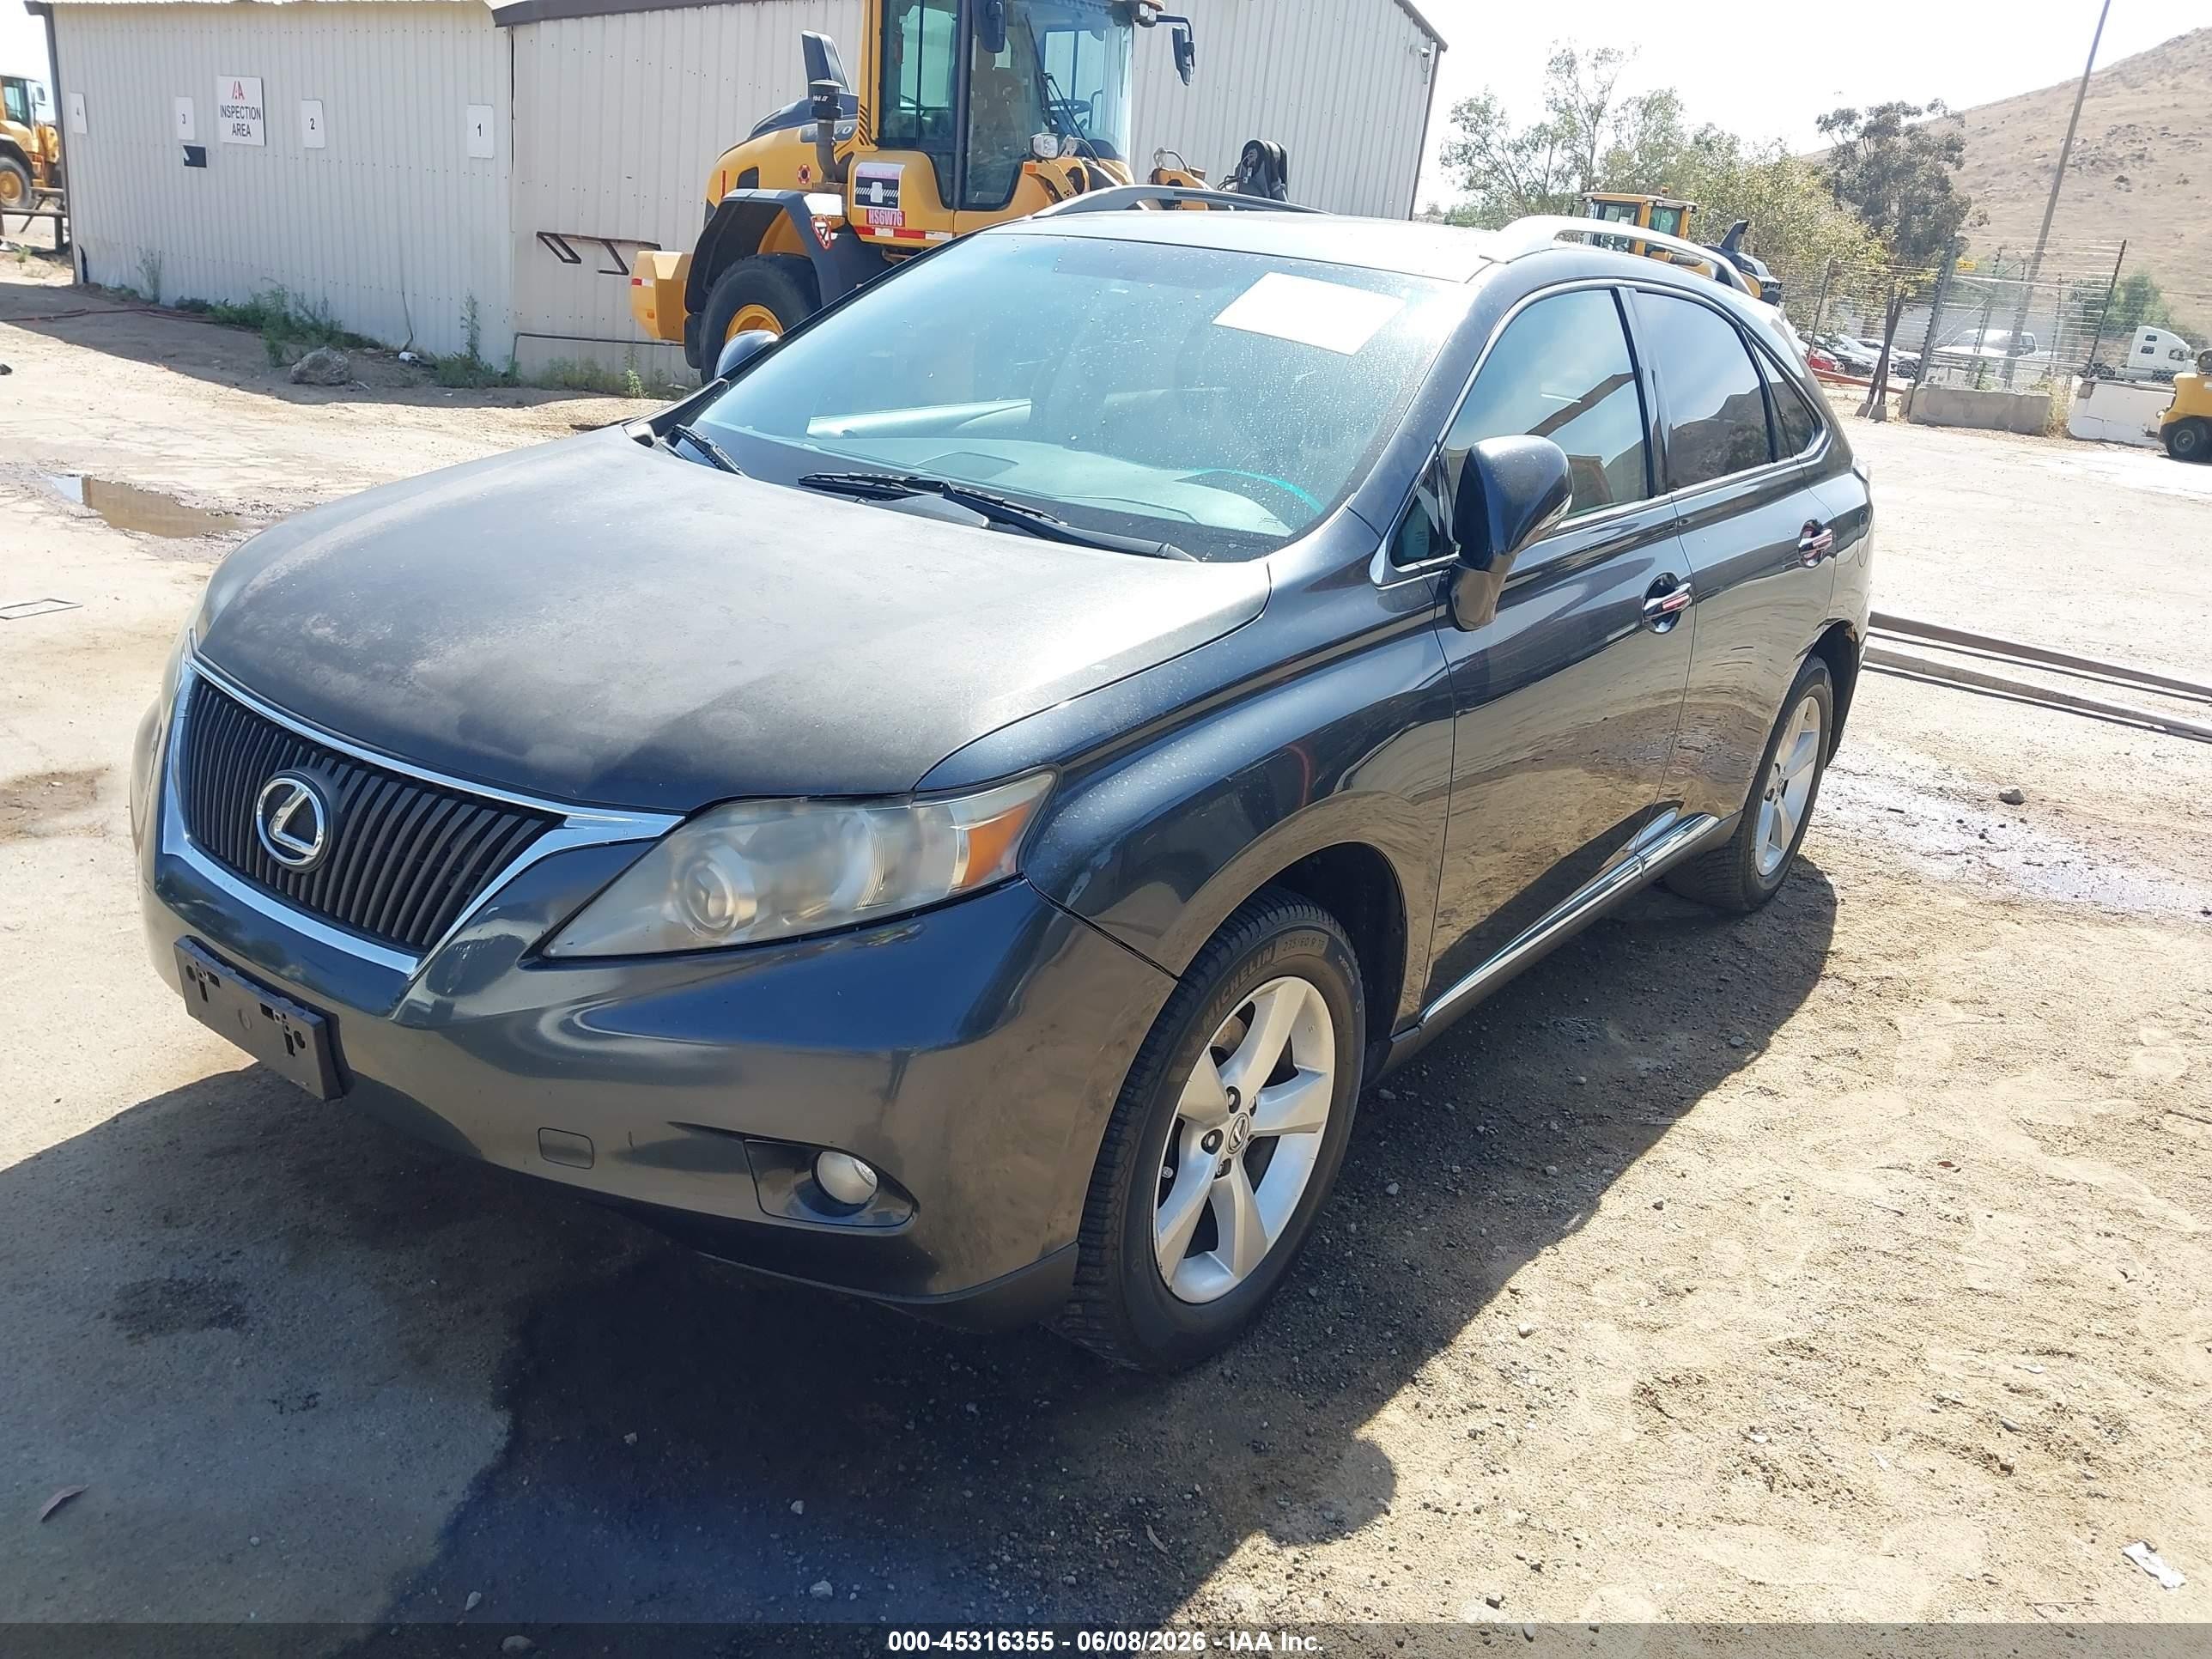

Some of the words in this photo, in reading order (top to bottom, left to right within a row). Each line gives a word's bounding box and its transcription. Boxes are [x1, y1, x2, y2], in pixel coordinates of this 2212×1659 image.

[220, 105, 261, 120] INSPECTION
[232, 123, 251, 137] AREA
[310, 118, 315, 130] 2
[477, 123, 482, 137] 1
[1202, 945, 1273, 1031] MICHELIN
